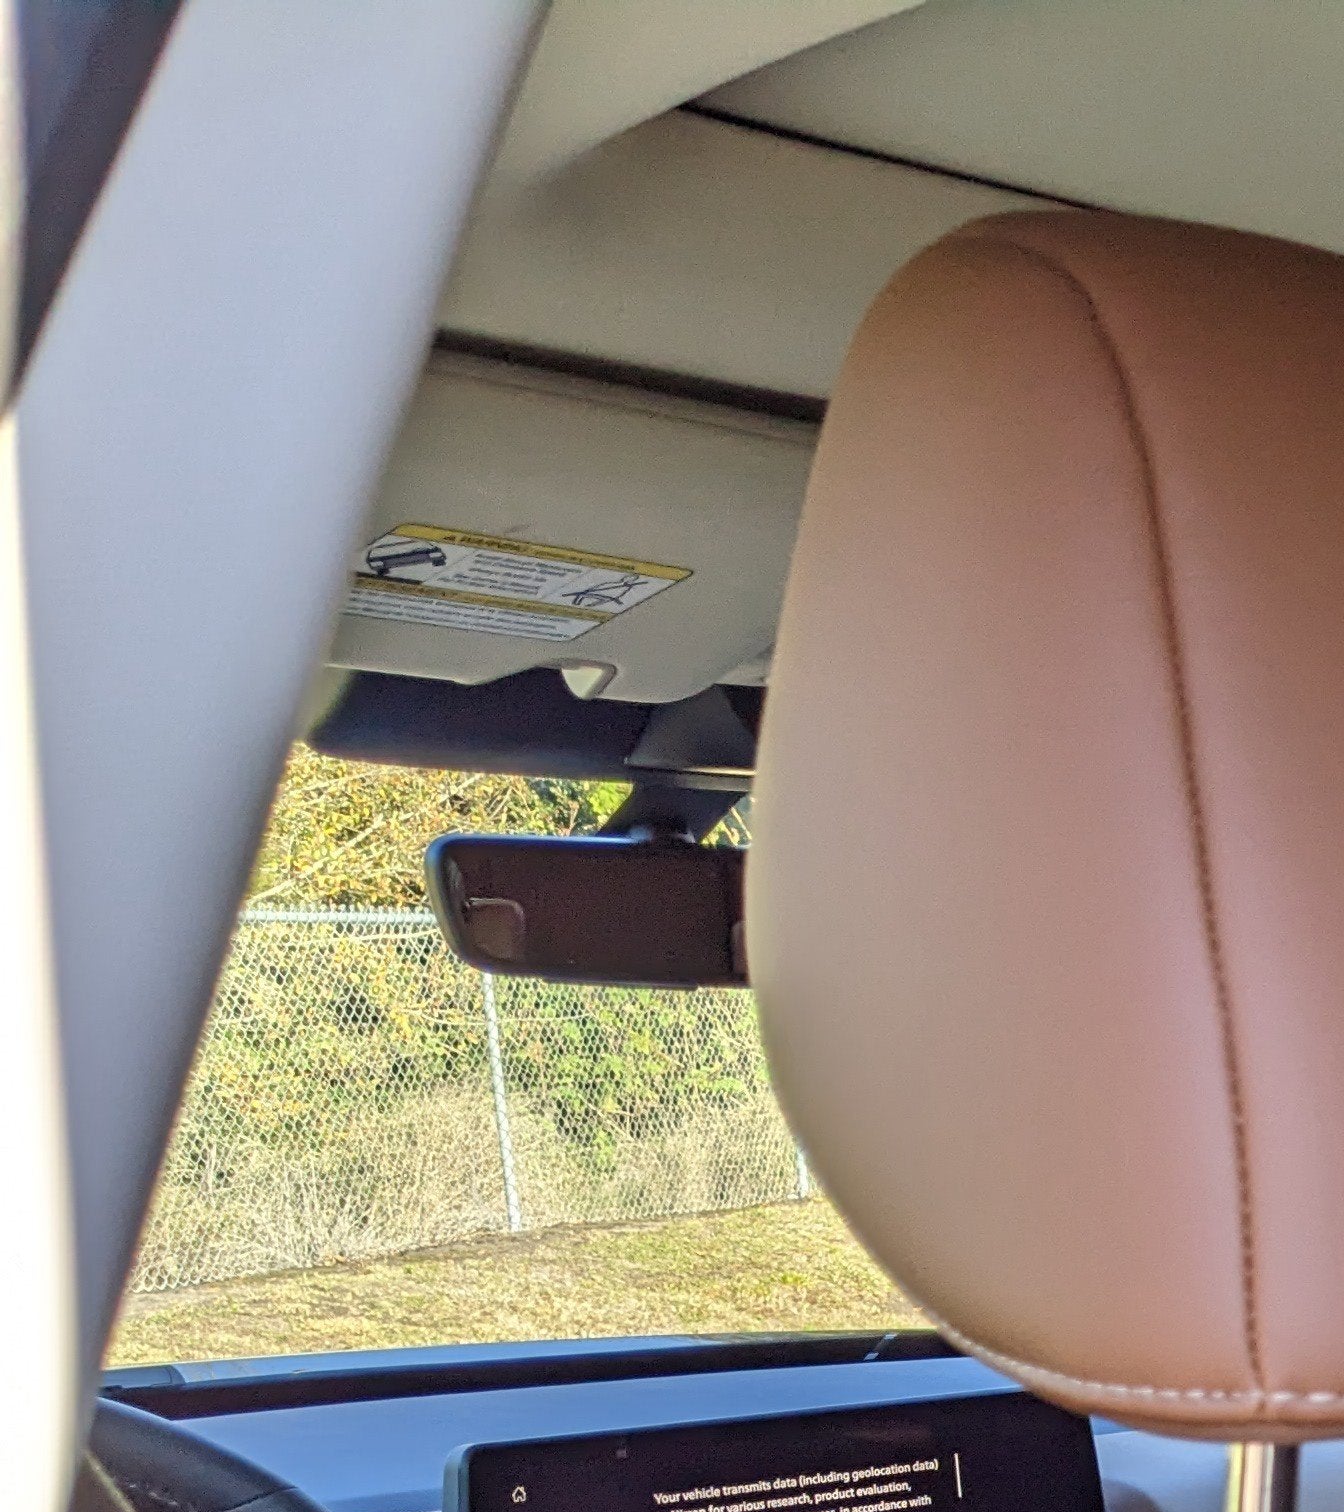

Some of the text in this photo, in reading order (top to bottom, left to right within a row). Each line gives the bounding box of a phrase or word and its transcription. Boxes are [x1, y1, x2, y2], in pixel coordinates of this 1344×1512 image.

[653, 1458, 939, 1504] Your vehicle transmits data (including geolocation data)
[766, 1493, 813, 1509] research,
[814, 1488, 855, 1504] product
[856, 1481, 912, 1496] evaluation,
[909, 1494, 932, 1507] with
